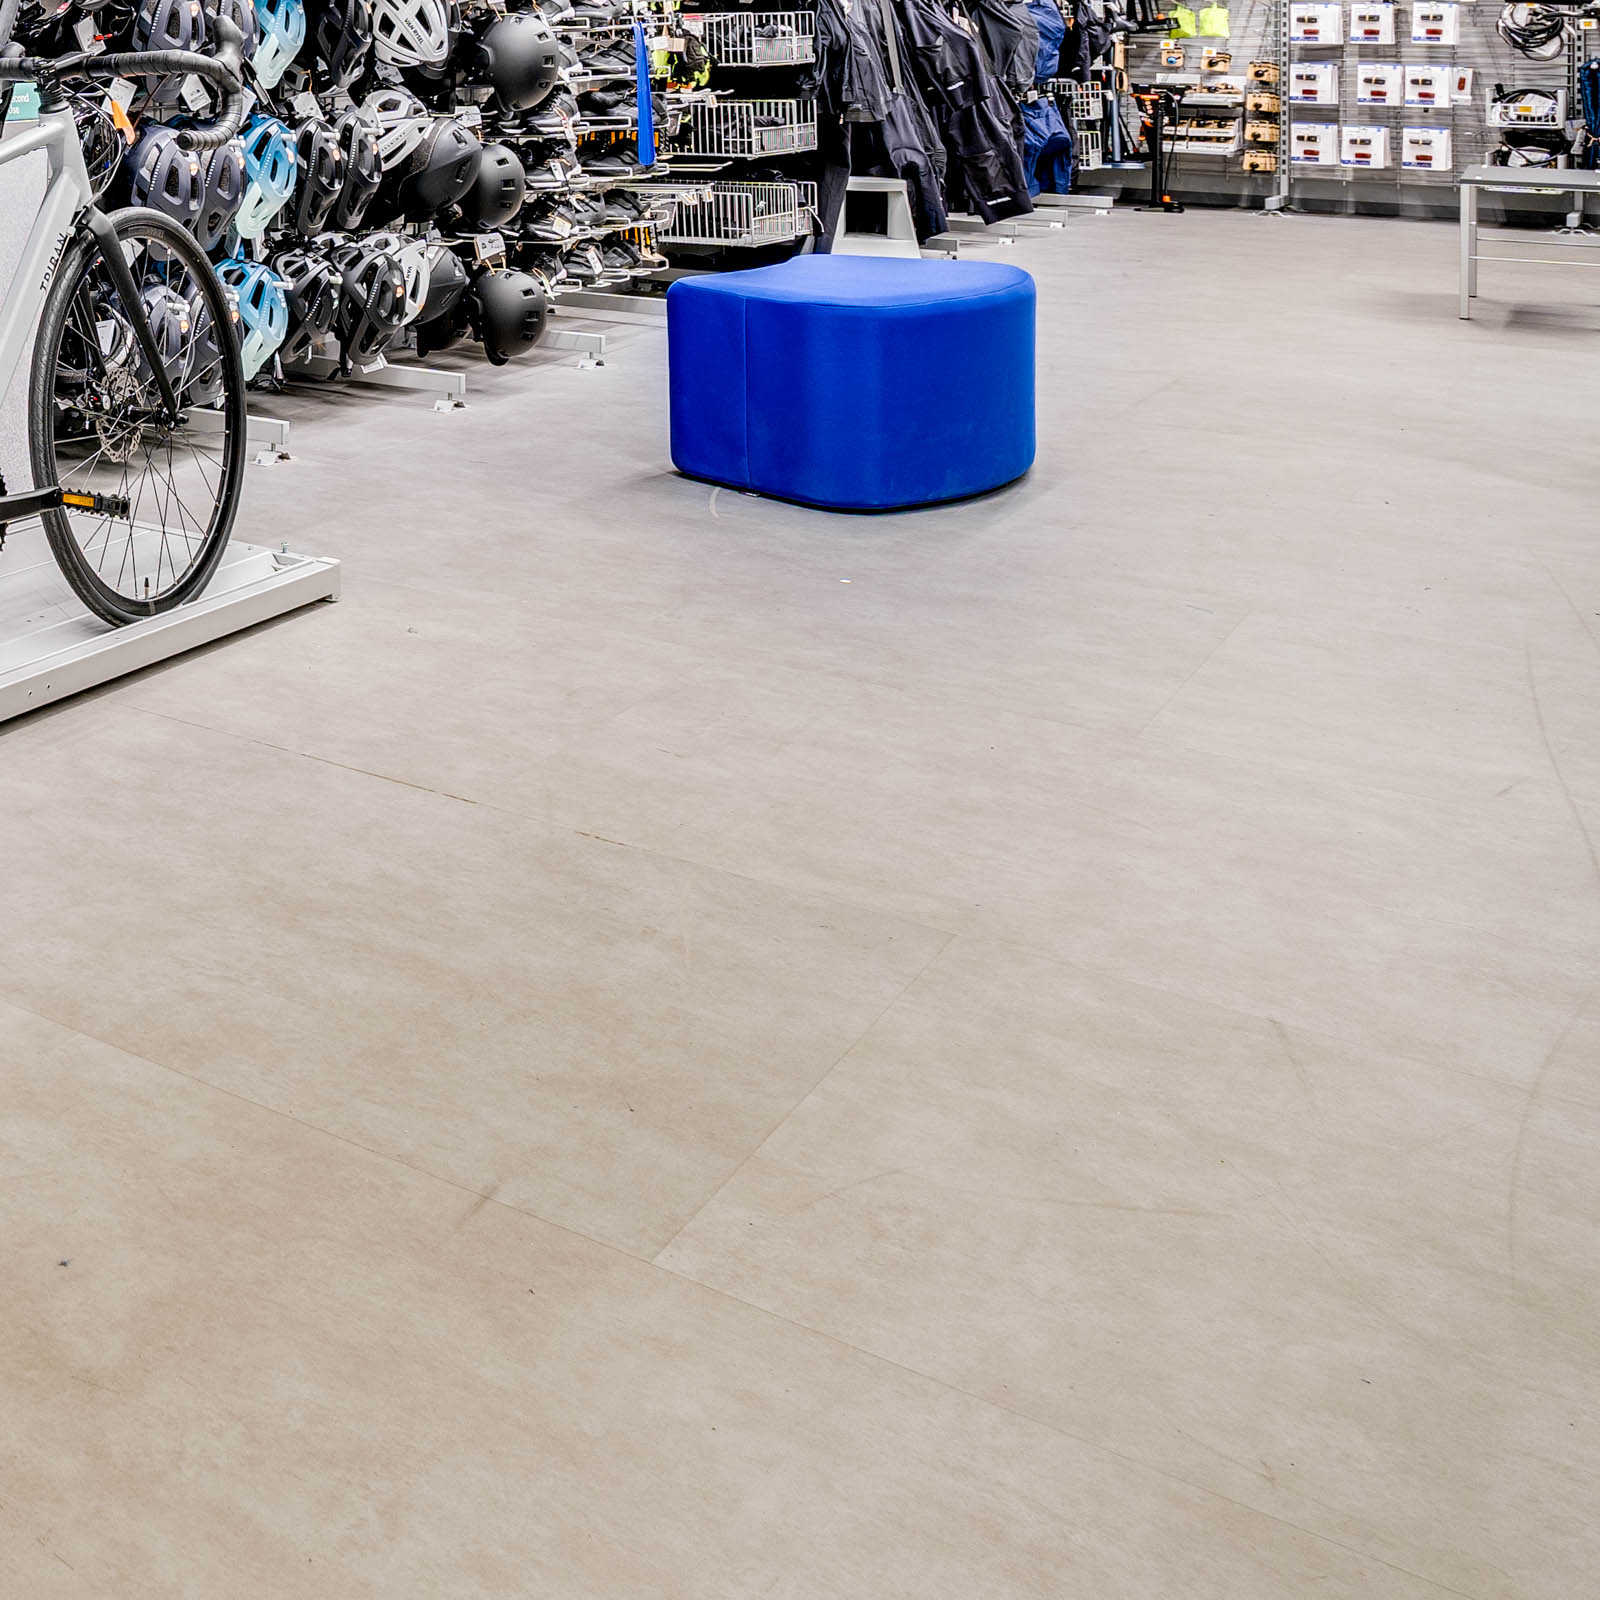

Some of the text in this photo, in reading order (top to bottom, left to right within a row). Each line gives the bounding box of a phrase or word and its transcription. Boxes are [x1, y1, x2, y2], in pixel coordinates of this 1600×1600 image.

[404, 17, 414, 30] VAN
[11, 94, 30, 103] econd
[40, 232, 67, 292] TRIBAN
